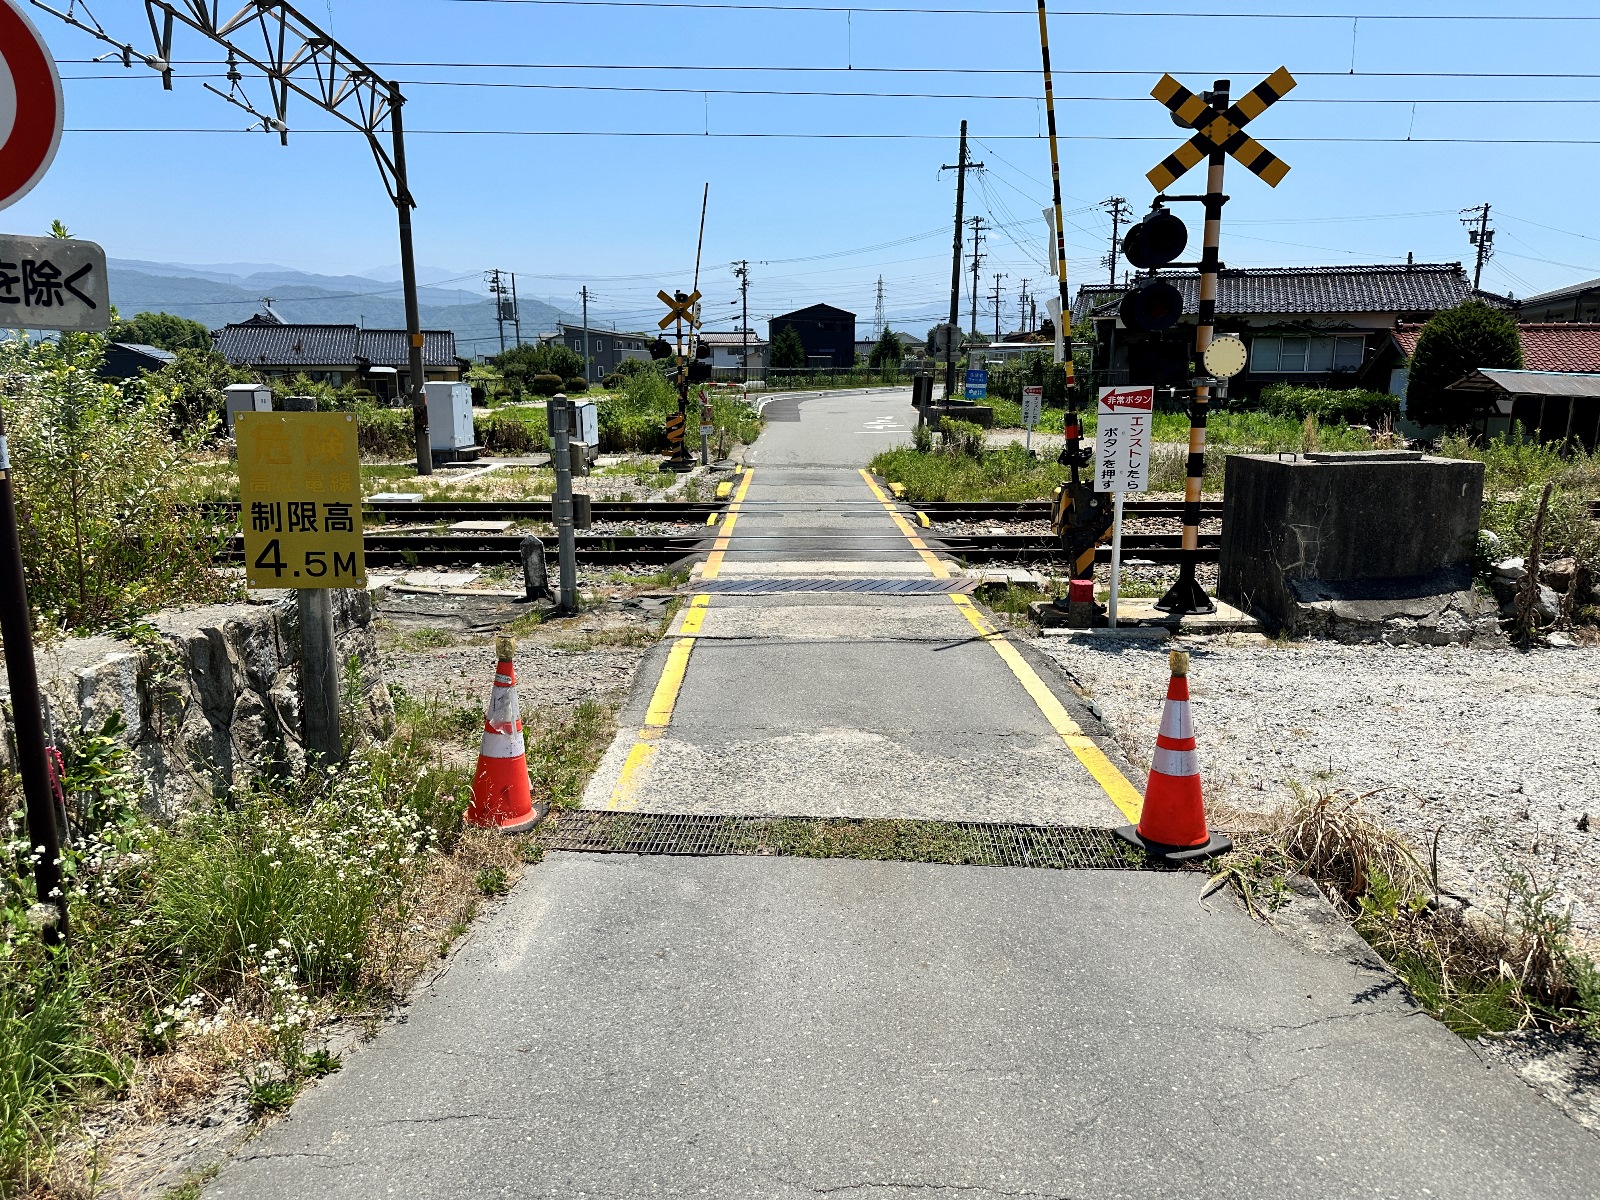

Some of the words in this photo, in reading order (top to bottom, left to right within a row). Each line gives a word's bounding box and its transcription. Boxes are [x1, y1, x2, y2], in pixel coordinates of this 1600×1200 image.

[1107, 395, 1152, 405] 非常ボタン
[251, 423, 347, 465] 危険
[1101, 427, 1118, 490] ボタンを押す
[1127, 416, 1144, 490] エンストしたら
[251, 501, 354, 533] 制限高
[254, 538, 357, 578] 4.5M
